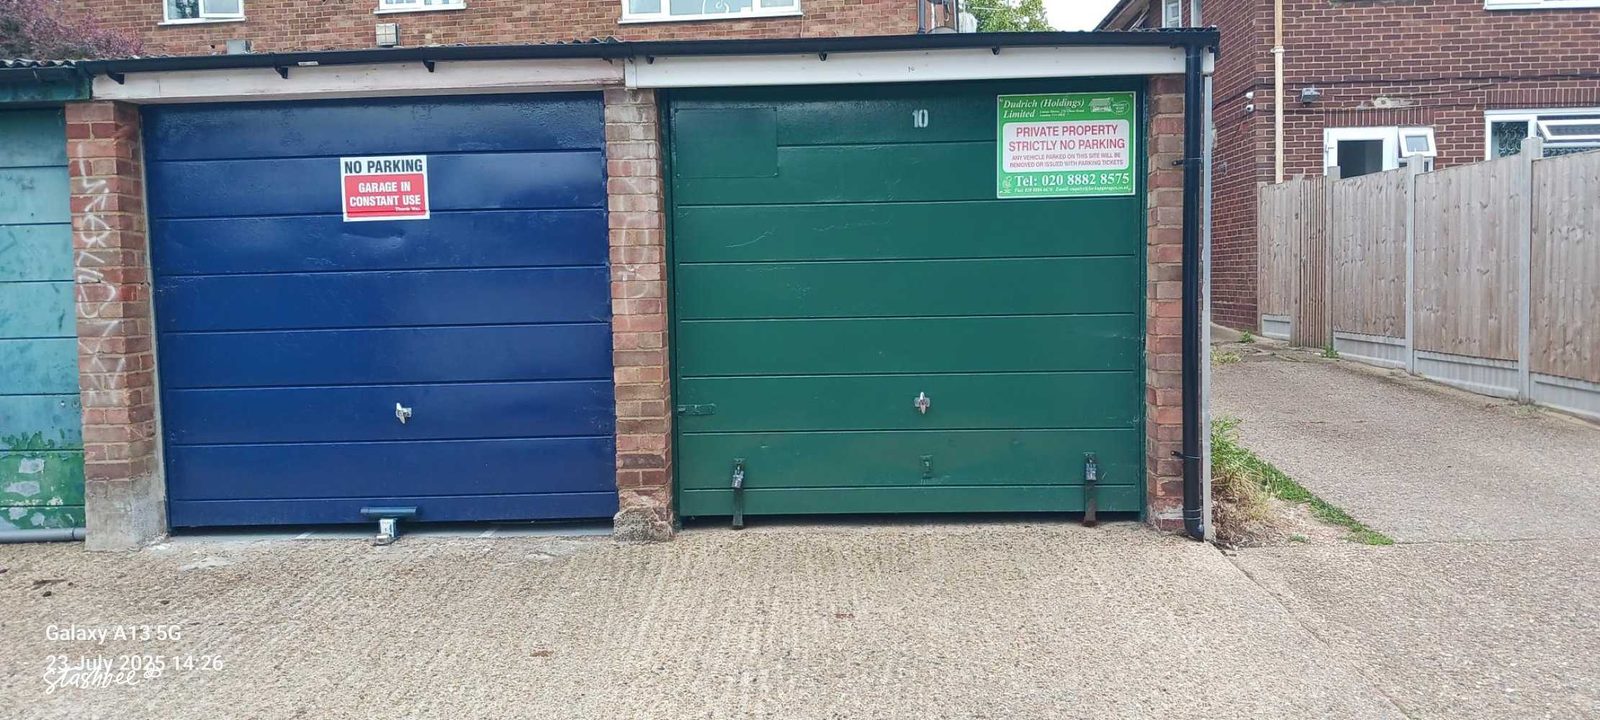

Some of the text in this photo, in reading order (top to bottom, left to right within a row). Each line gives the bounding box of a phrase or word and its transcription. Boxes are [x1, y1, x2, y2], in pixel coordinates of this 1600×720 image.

[1003, 98, 1085, 109] Dudrich (Holdings)
[912, 109, 928, 128] 10
[1003, 109, 1036, 119] Limited
[1016, 124, 1118, 137] PRIVATE PROPERTY
[1009, 138, 1125, 152] STRICTLY NO PARKING
[344, 158, 423, 174] NO PARKING
[1015, 173, 1129, 187] Tel: 020 8882 8575
[358, 181, 411, 193] GARAGE IN
[349, 194, 421, 207] CONSTANT USE
